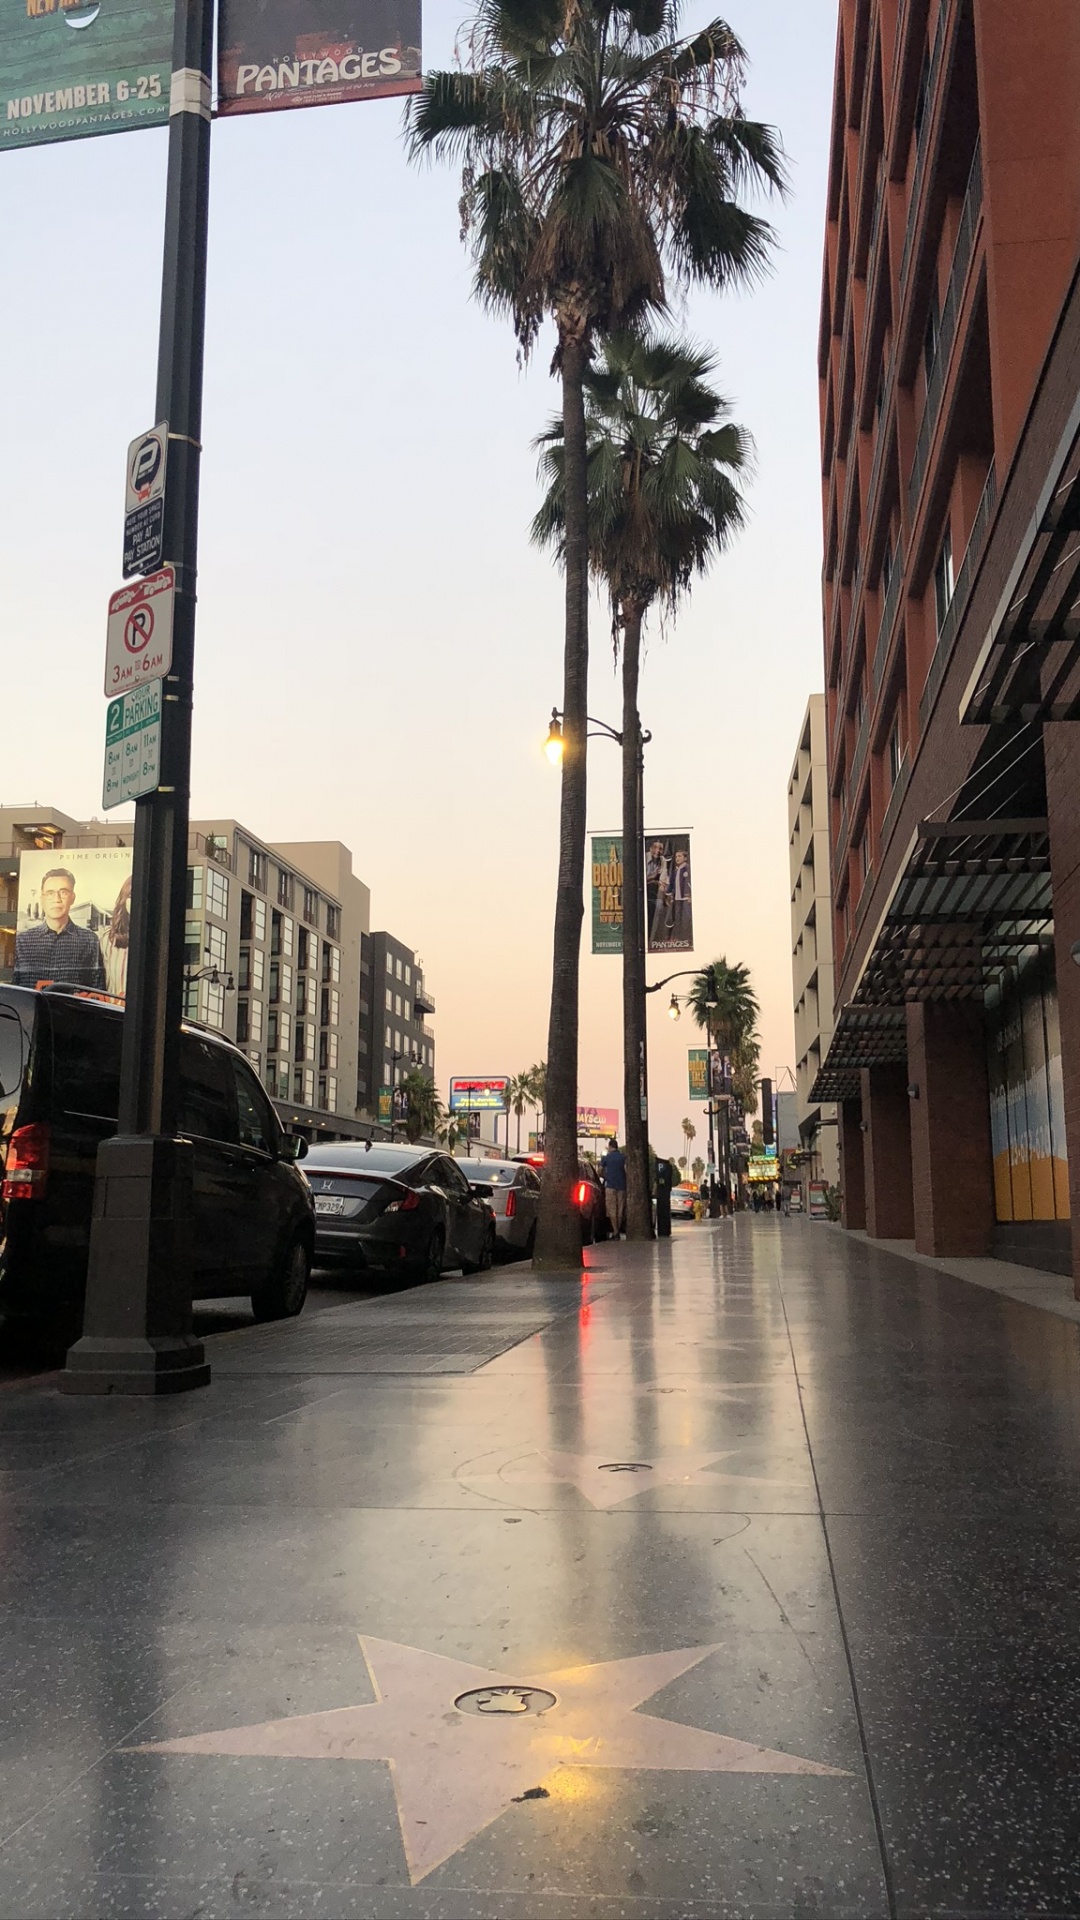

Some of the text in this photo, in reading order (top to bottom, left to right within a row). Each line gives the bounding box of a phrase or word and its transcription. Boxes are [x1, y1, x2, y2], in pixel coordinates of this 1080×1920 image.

[273, 46, 364, 65] HOLLYWOOD
[235, 48, 402, 95] PANTAGES
[7, 74, 162, 120] NOVEMBER 6-25
[3, 106, 165, 137] HOLLYWOODPANTAGES.COM
[132, 524, 153, 546] PAY AT
[124, 533, 161, 564] PAY STATION
[112, 665, 133, 683] 3AM
[142, 653, 163, 671] 6AM
[110, 703, 121, 732] 2
[124, 692, 159, 728] PARKING
[108, 751, 120, 765] 8AM
[125, 743, 138, 756] 8AM
[142, 762, 156, 776] 8PM
[599, 886, 624, 910] TAL
[651, 940, 690, 949] PANTAGES
